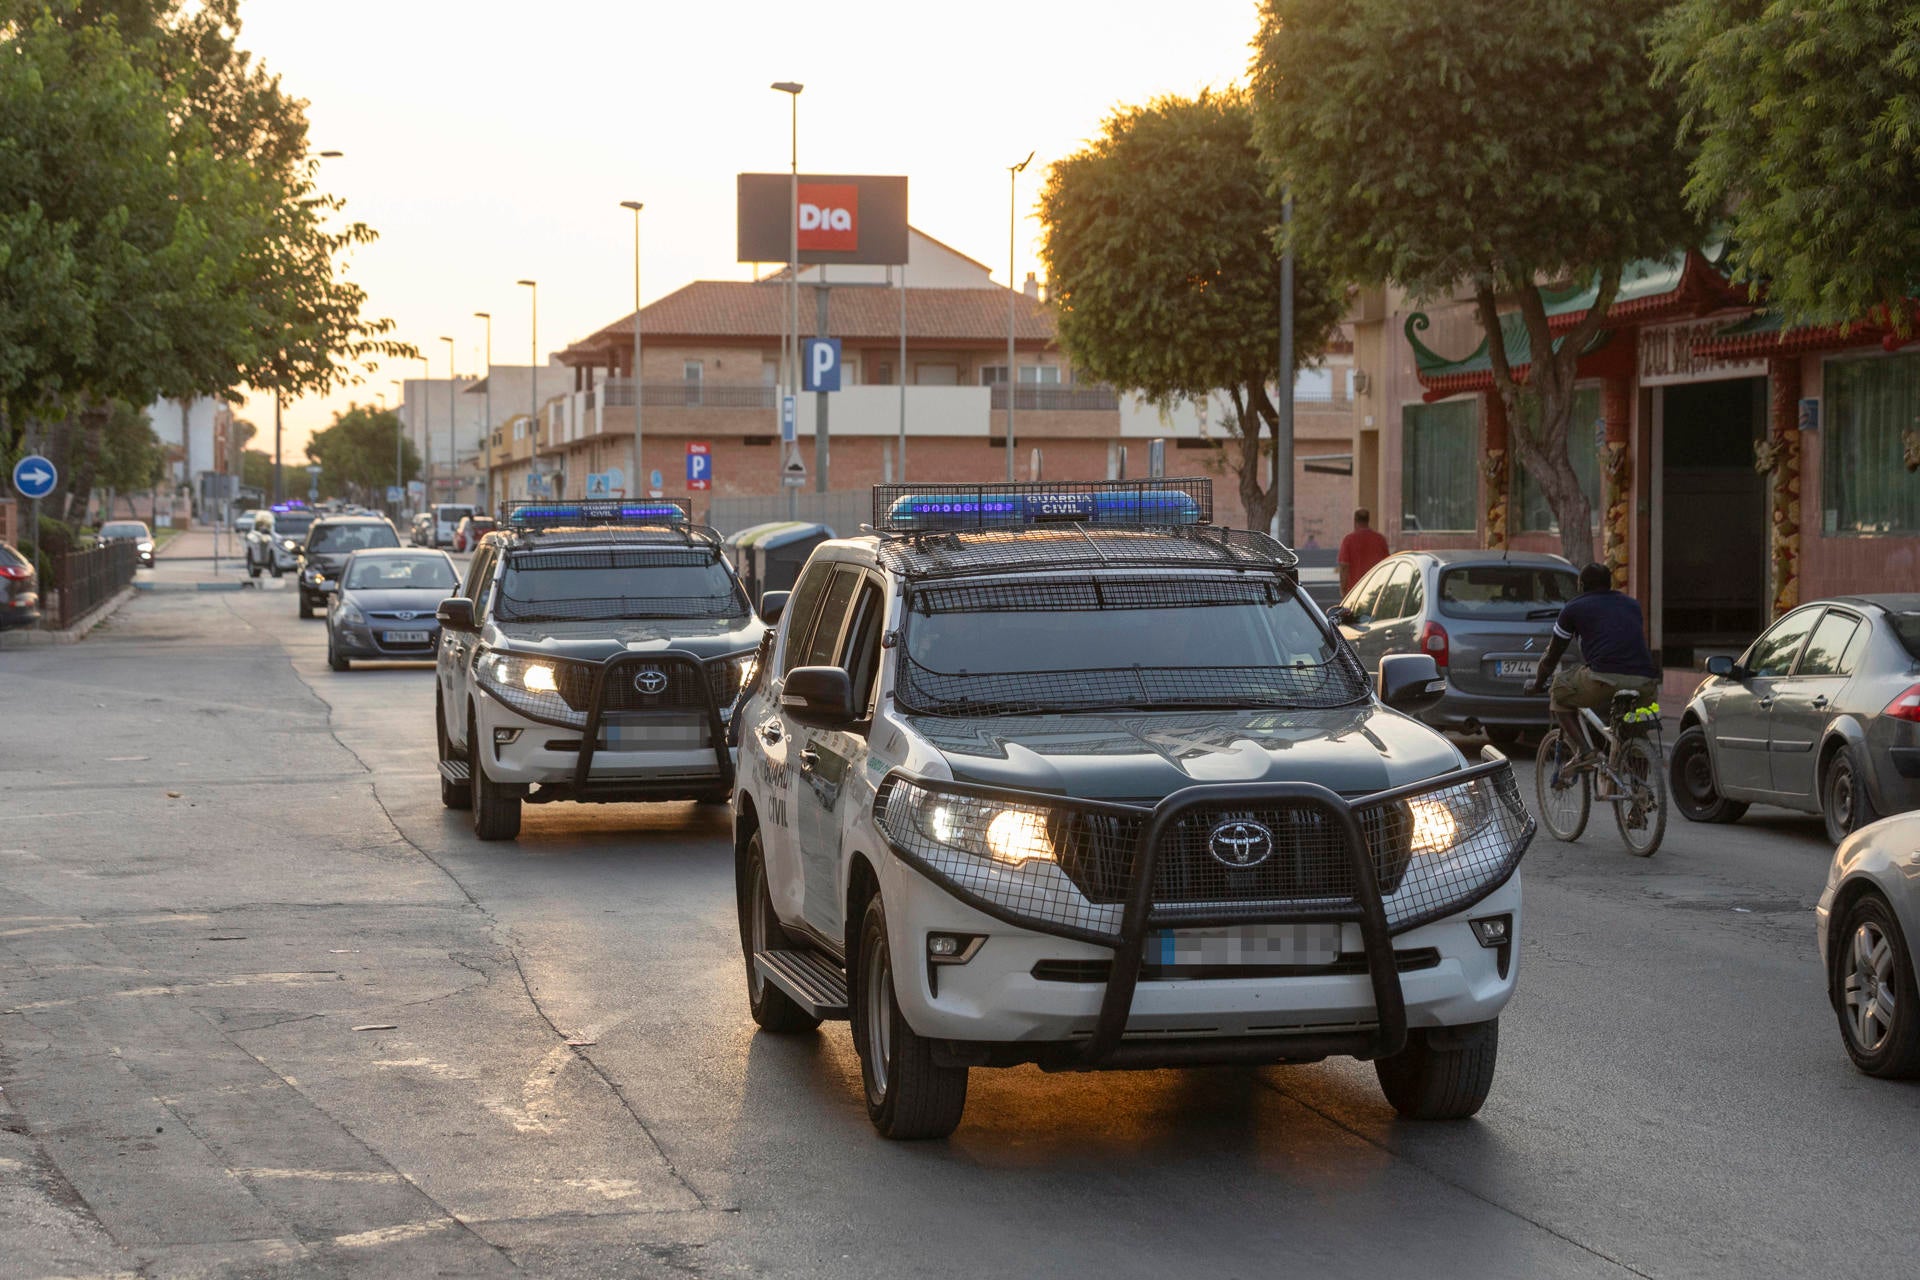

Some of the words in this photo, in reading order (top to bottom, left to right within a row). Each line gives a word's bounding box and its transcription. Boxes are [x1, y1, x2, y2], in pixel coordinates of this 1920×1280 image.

[812, 342, 835, 387] P
[693, 455, 705, 479] P
[1027, 494, 1093, 504] GUARDIA
[1042, 504, 1082, 514] CIVIL
[1503, 661, 1532, 673] 3744
[768, 794, 788, 828] CIVIL
